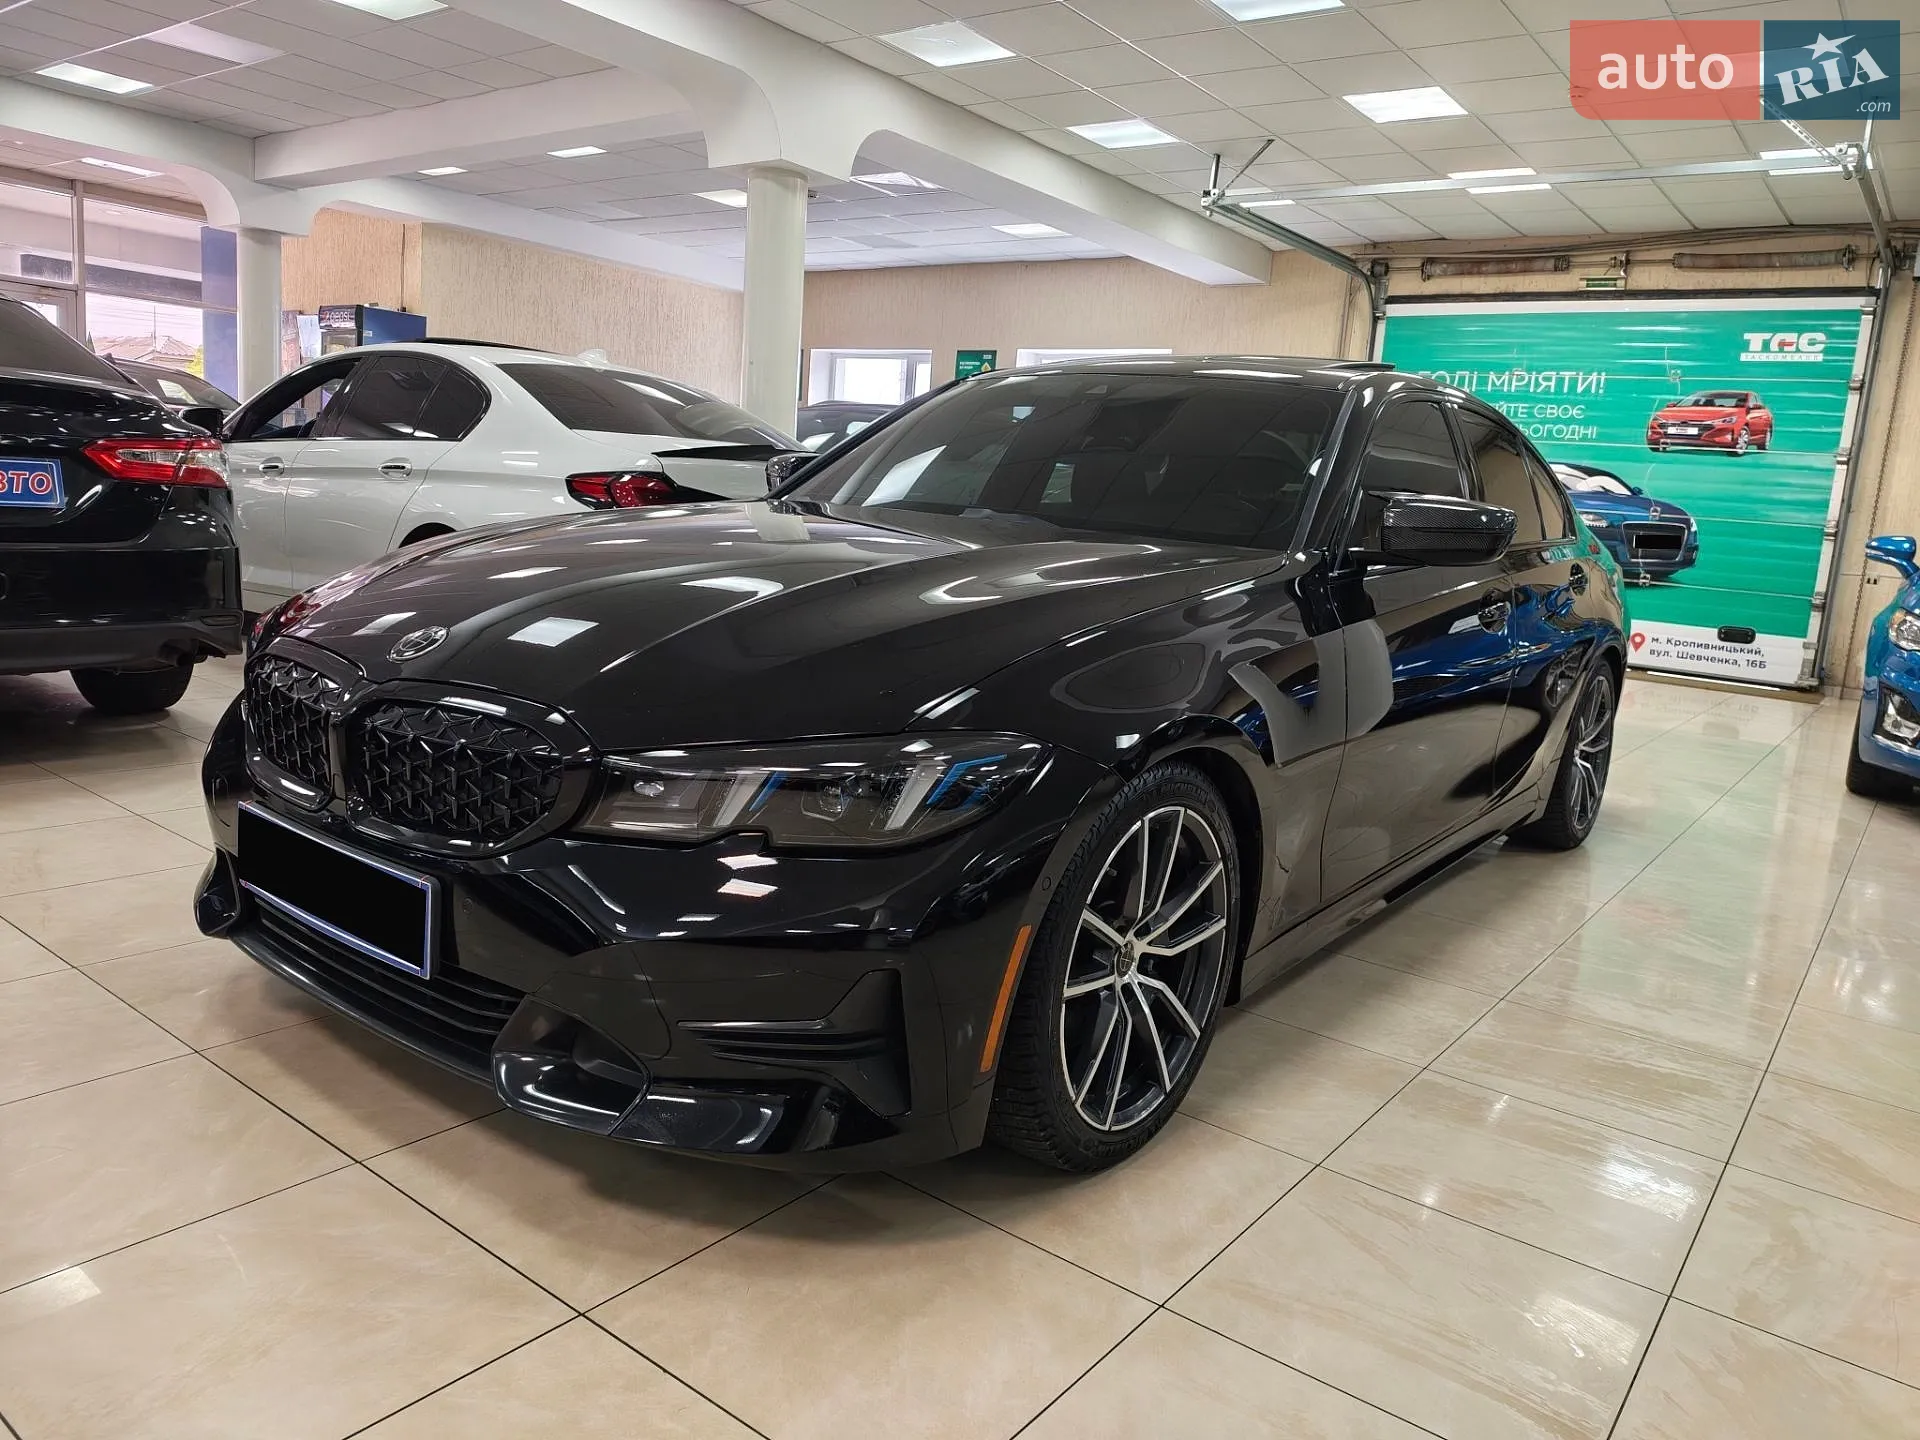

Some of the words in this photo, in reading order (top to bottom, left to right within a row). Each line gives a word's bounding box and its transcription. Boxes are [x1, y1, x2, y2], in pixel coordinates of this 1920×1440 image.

[1487, 371, 1608, 394] МРІЯТИ!
[1534, 404, 1586, 419] СВОЄ
[1651, 636, 1662, 645] м.
[1665, 637, 1765, 658] Кропивницький,
[1649, 647, 1673, 658] вул.
[1676, 650, 1742, 668] Шевченка,
[1746, 658, 1767, 670] 16Б
